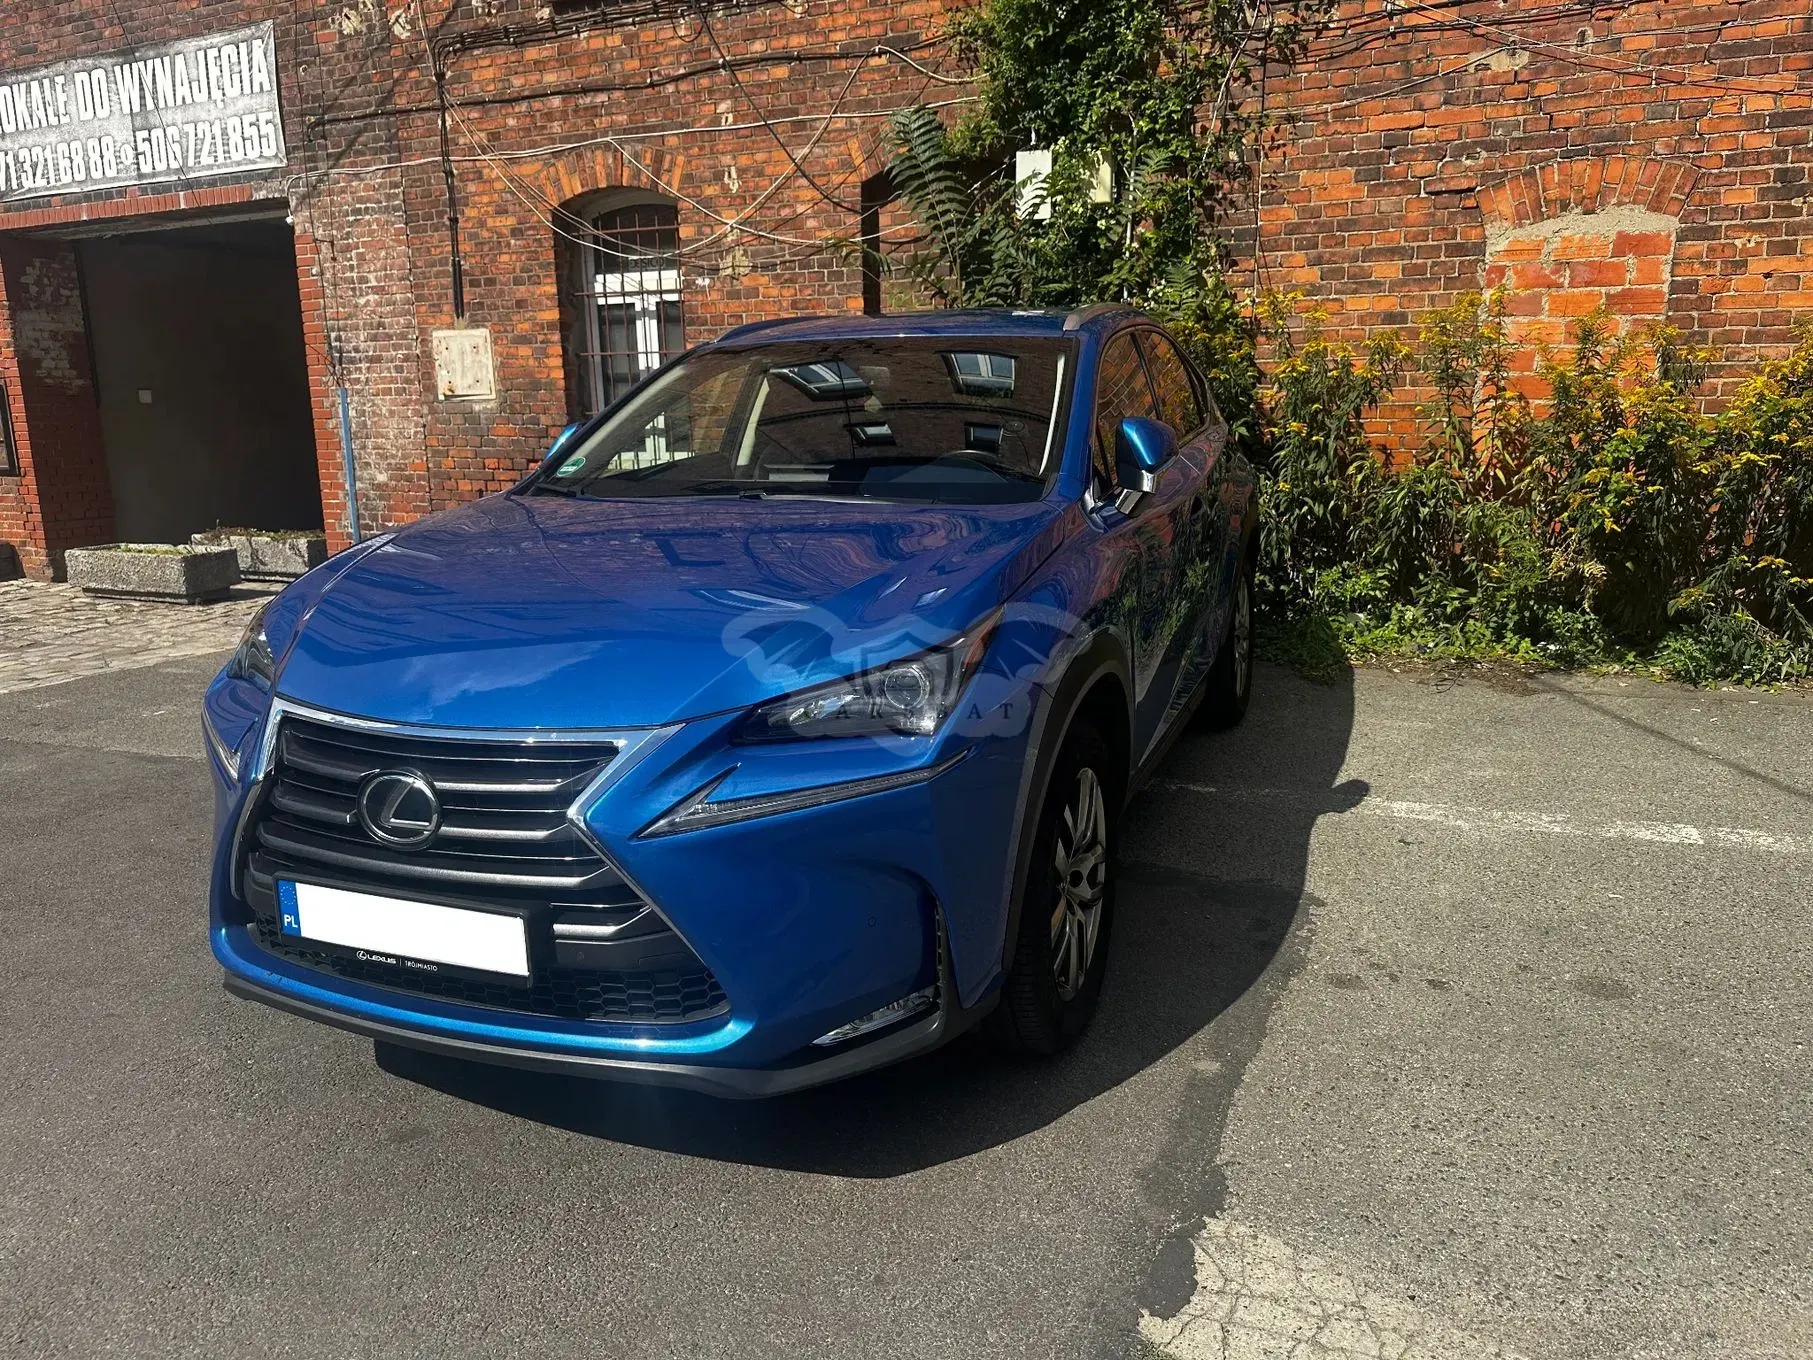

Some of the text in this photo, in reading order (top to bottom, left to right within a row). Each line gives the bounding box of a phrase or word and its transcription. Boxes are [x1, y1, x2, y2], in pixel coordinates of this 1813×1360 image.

[0, 38, 271, 134] OKALE DO WYNAJĘCIA
[227, 111, 277, 162] 855
[284, 913, 298, 928] PL
[367, 954, 397, 965] LEXUS
